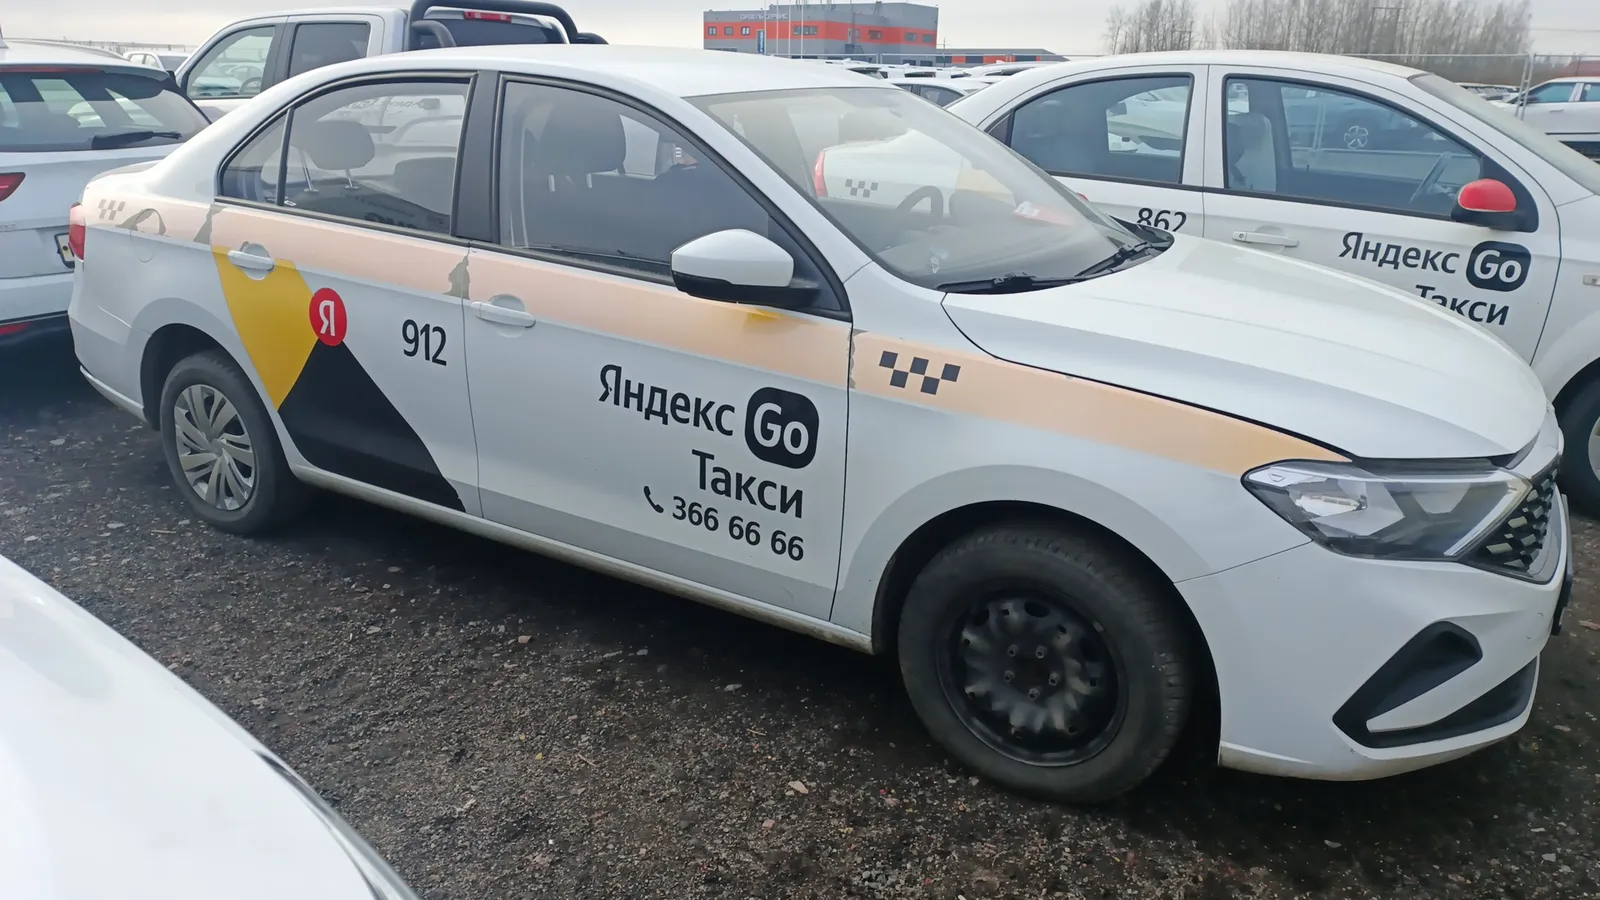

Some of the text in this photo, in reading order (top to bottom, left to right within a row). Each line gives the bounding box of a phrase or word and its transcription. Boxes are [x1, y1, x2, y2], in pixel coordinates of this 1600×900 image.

[1136, 207, 1187, 232] 862
[1338, 231, 1523, 284] Яндекс Go
[318, 299, 336, 337] Я
[402, 318, 447, 366] 912
[598, 363, 810, 455] Яндекс Go
[691, 448, 804, 519] Такси
[672, 495, 805, 561] 366 66 66
